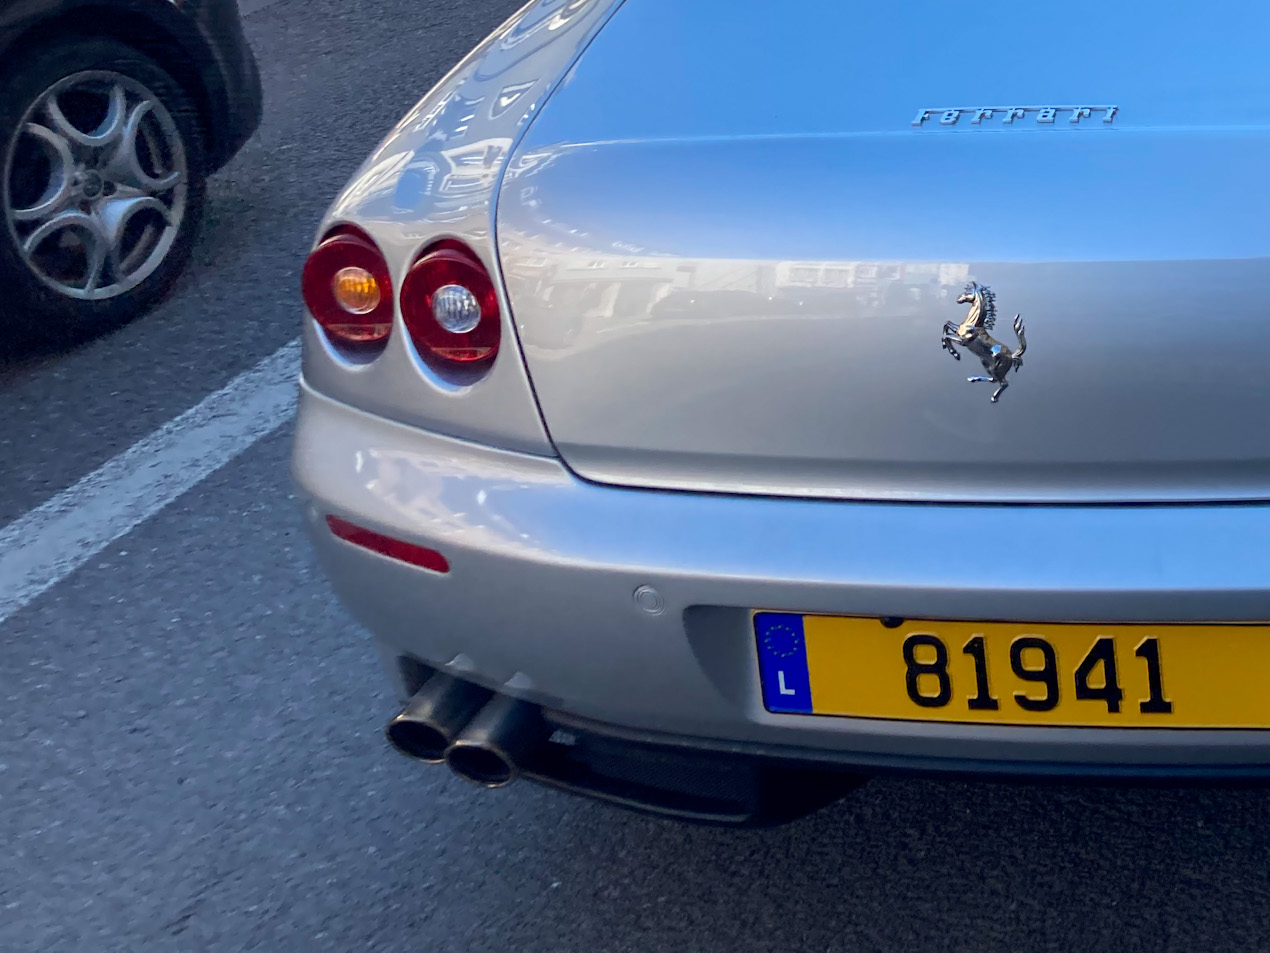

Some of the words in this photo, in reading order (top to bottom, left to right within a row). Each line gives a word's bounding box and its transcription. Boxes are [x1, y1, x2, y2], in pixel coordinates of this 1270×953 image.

[911, 104, 1120, 127] Ferrari
[778, 670, 796, 696] L
[902, 633, 1173, 714] 81941
